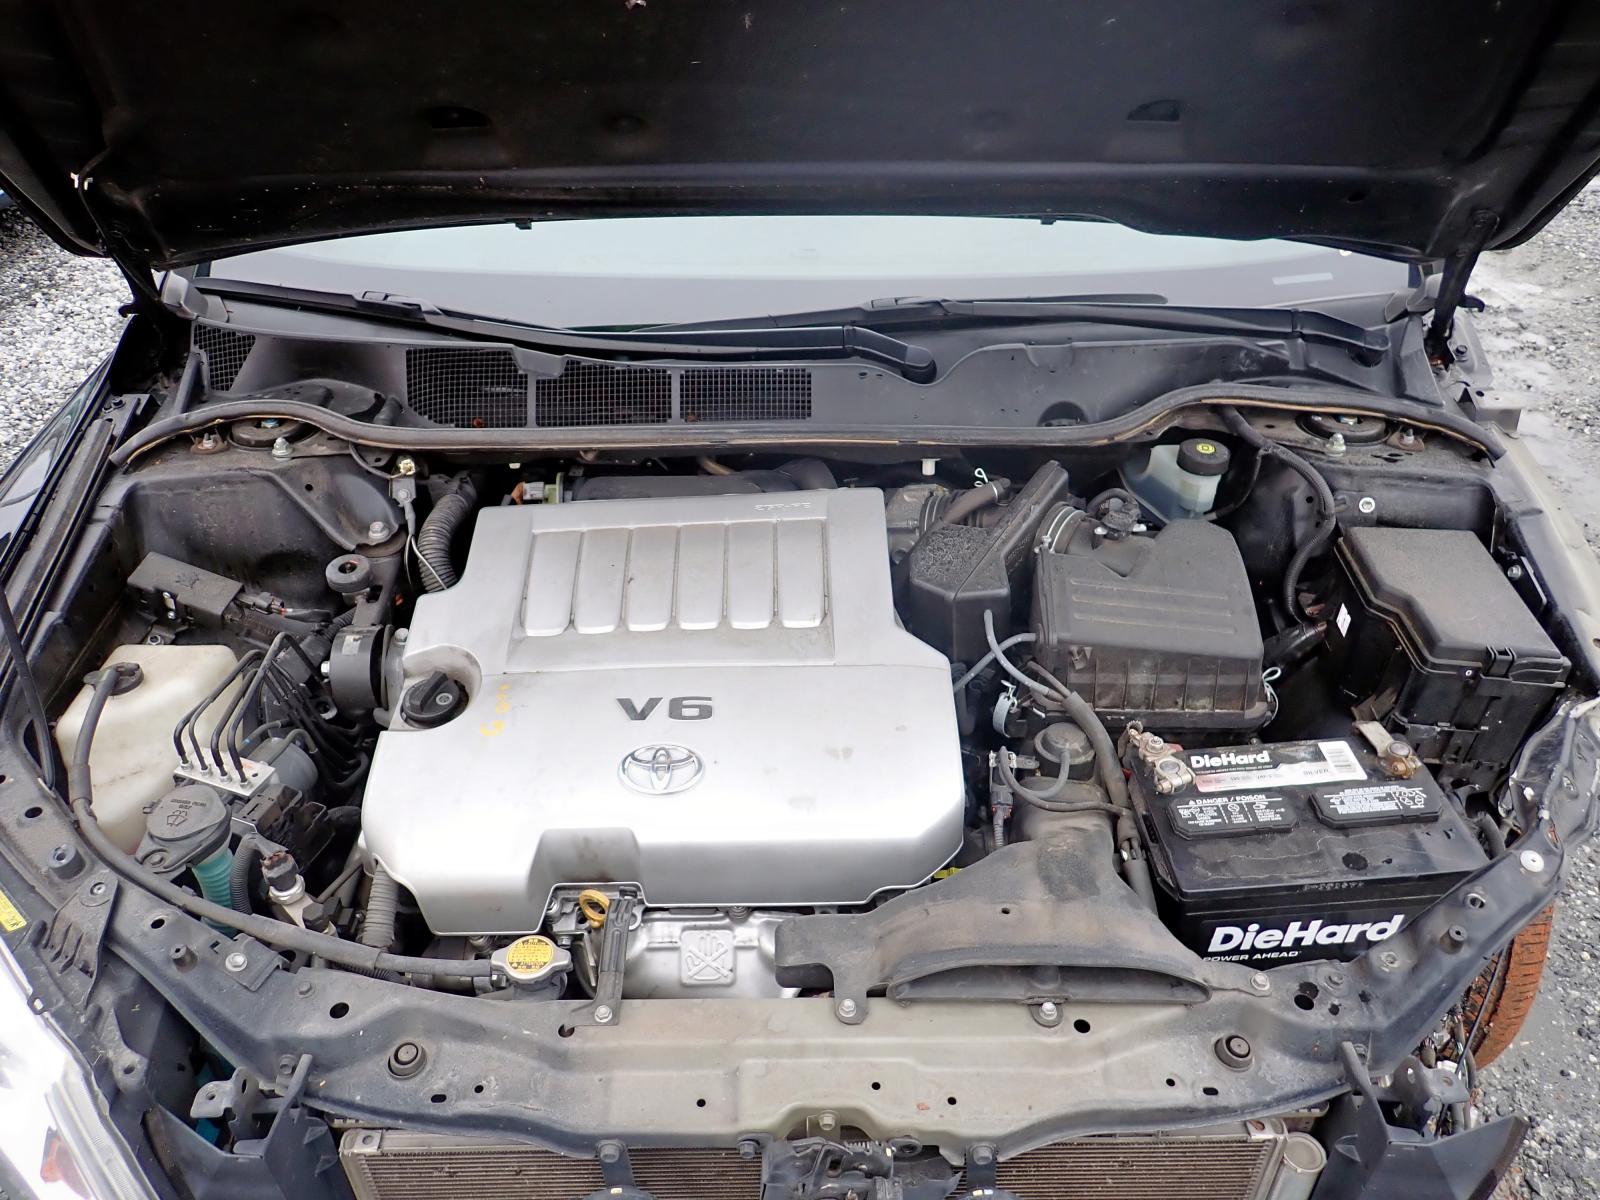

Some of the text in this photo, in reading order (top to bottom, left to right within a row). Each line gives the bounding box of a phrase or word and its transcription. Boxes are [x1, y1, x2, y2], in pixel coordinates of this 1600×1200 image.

[616, 696, 712, 720] V6
[1190, 751, 1270, 768] DieHard
[1196, 797, 1228, 805] DANGER
[1236, 794, 1267, 802] POISON
[1207, 914, 1405, 952] DieHard
[1202, 951, 1298, 962] POWER AHEAD
